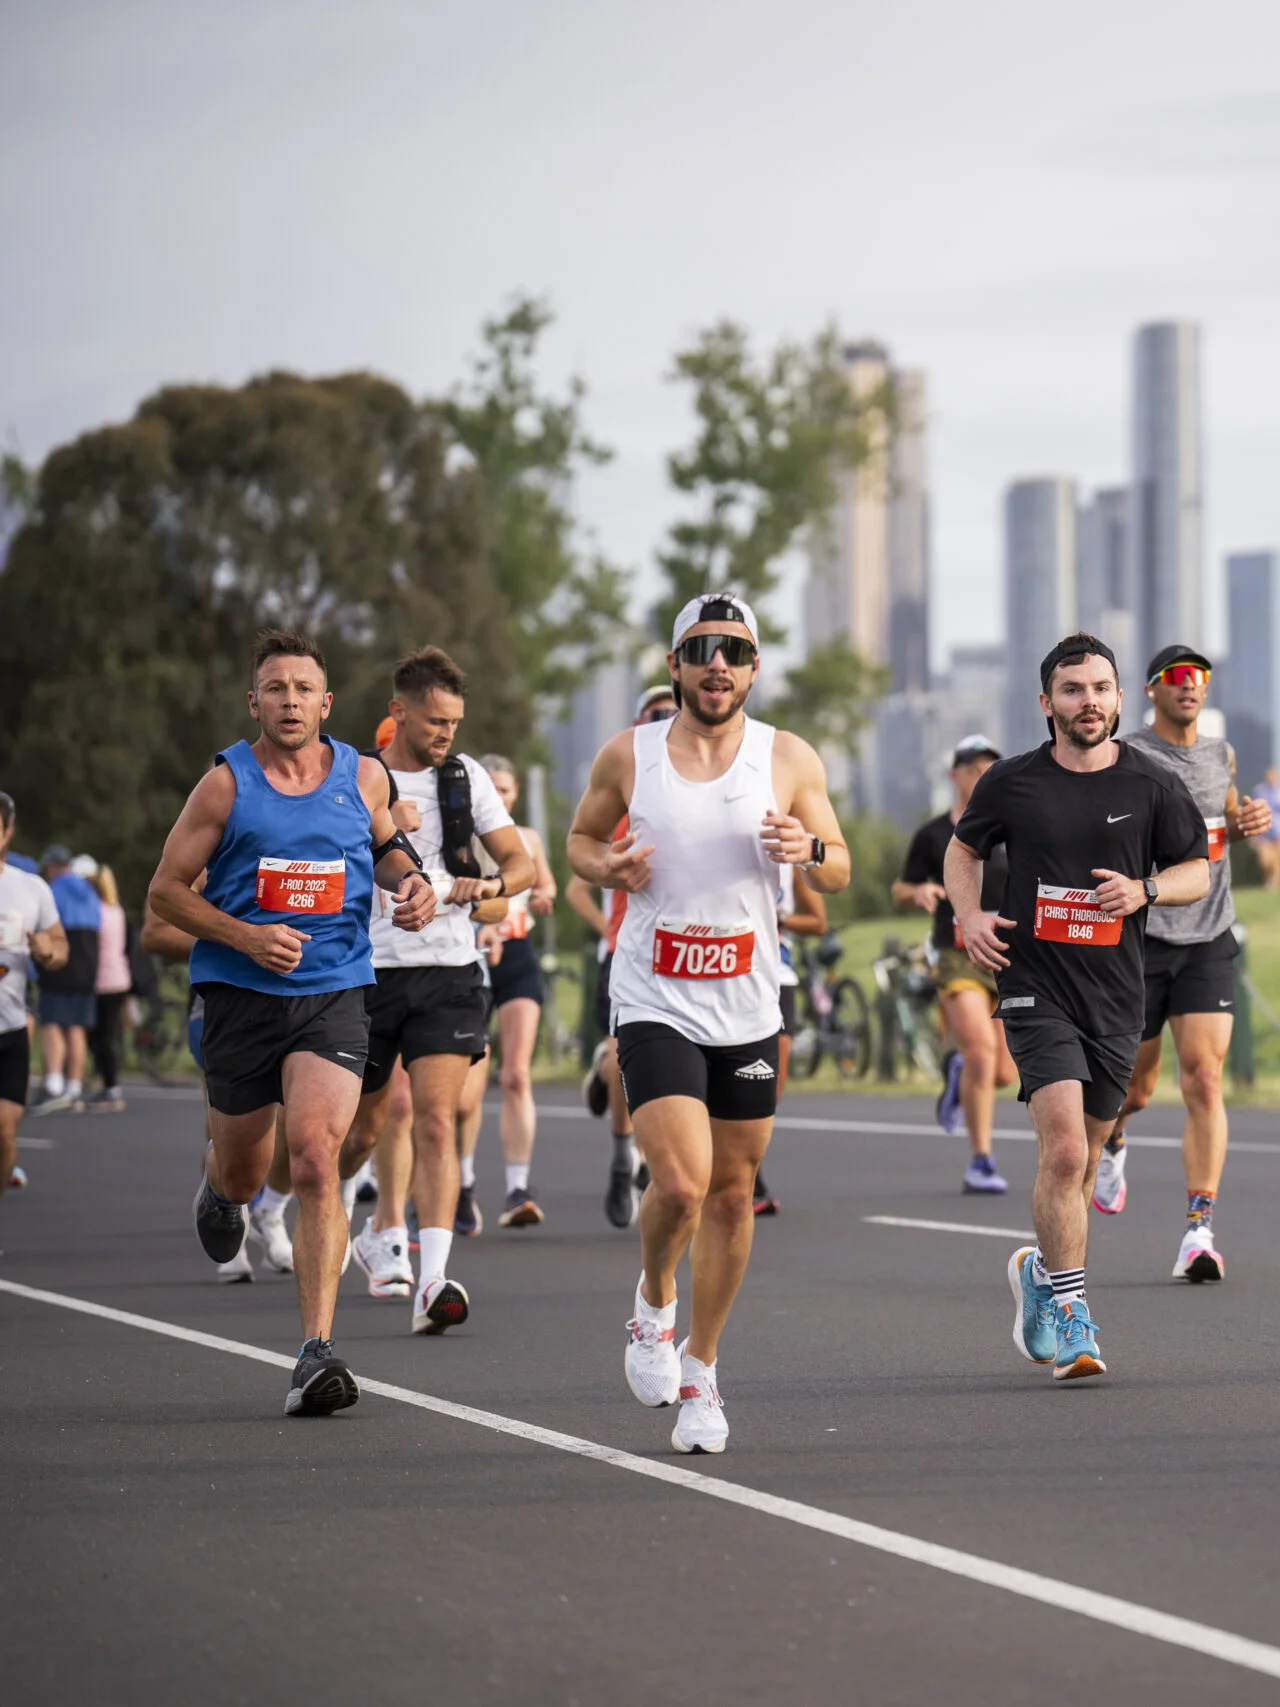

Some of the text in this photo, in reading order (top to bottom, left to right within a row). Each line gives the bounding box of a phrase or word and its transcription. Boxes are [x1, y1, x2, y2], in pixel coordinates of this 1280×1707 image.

[279, 878, 326, 891] J-ROD 2023
[287, 893, 315, 908] 4266
[1044, 905, 1117, 923] CHRIS THOROGO
[1067, 924, 1094, 939] 1846
[671, 941, 738, 975] 7026
